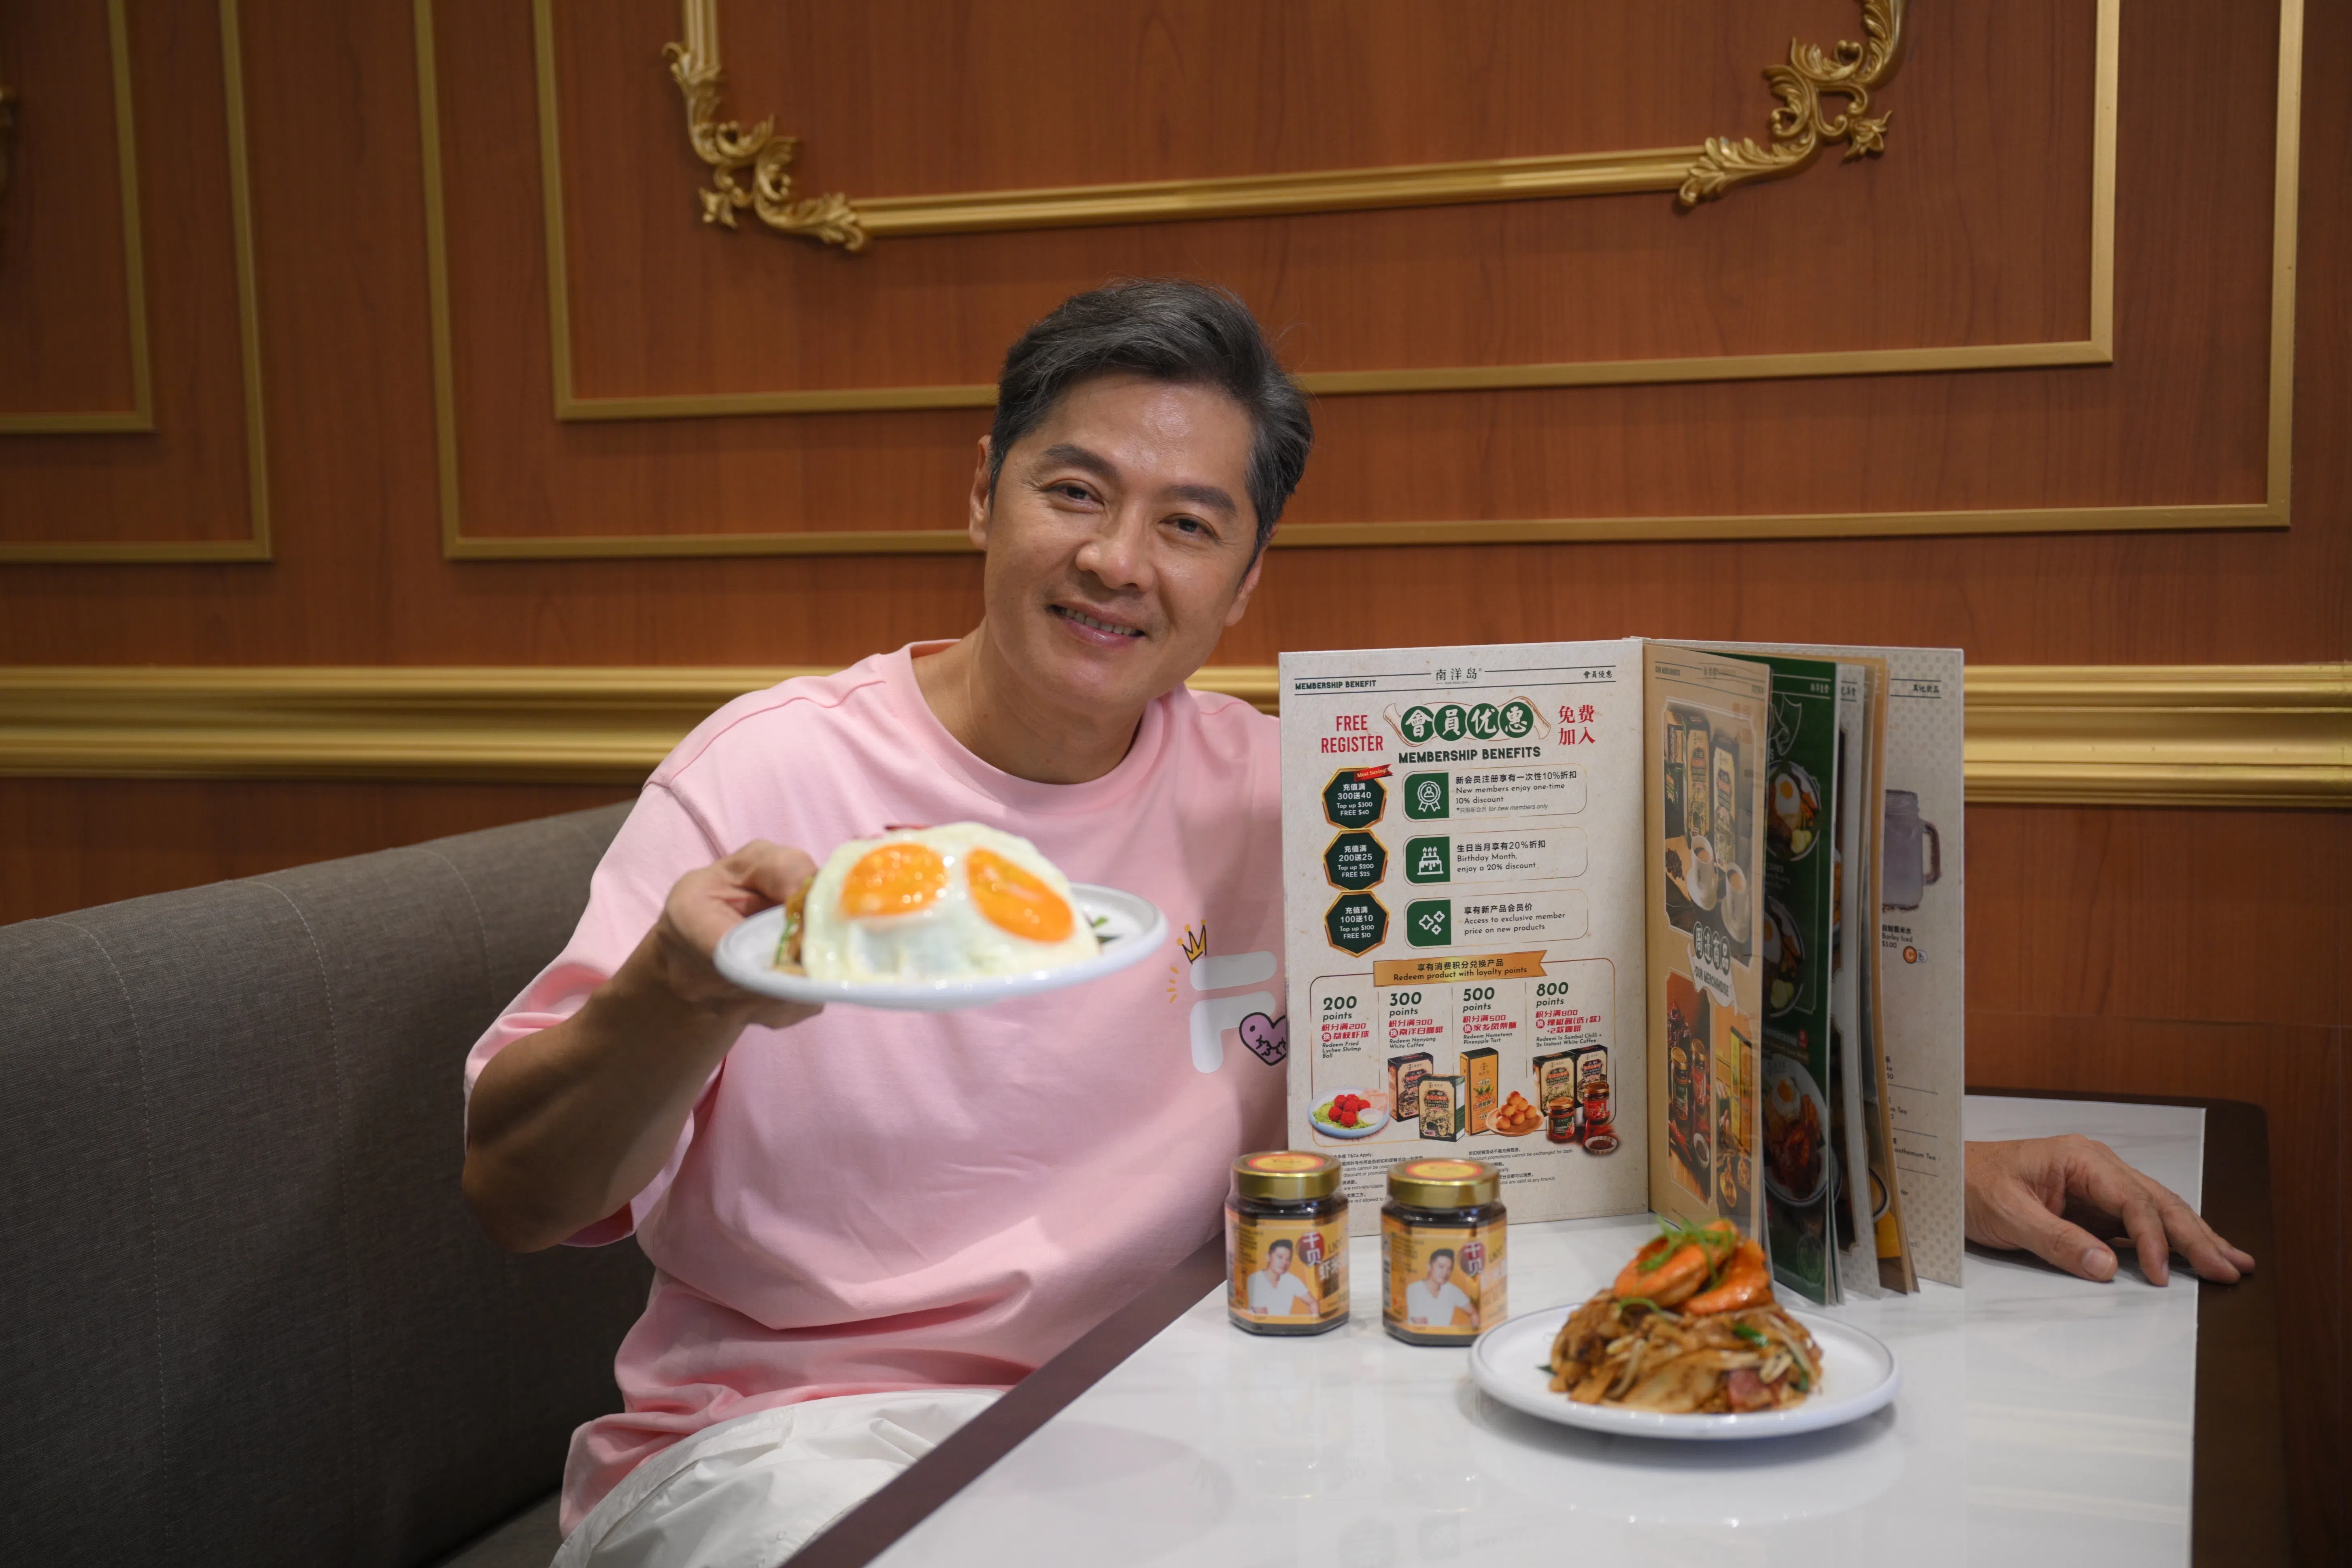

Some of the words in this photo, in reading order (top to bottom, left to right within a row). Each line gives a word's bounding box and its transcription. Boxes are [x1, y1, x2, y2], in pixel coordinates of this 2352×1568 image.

[1295, 681, 1343, 690] MEMBERSHIP
[1558, 705, 1595, 725] 免费
[1336, 715, 1368, 731] FREE
[1558, 727, 1596, 746] 加入
[1321, 735, 1383, 753] REGISTER
[1399, 749, 1478, 764] MEMBERSHIP
[1482, 746, 1541, 760] BENEFITS
[1455, 771, 1577, 784] 新会员注册享有一次性10%折扣
[1338, 792, 1371, 800] 300送40
[1344, 845, 1367, 853] 充值满
[1457, 840, 1545, 852] 生日当月享有20%折扣
[1339, 853, 1373, 862] 200送25
[1458, 854, 1489, 862] Birthday
[1457, 865, 1477, 873] enjoy
[1345, 906, 1368, 914] 充值满
[1464, 903, 1532, 915] 享有新产品会员价
[1340, 915, 1373, 923] 100送10
[1501, 914, 1533, 922] exclusive
[1536, 911, 1565, 920] member
[1464, 927, 1482, 936] price
[1514, 924, 1545, 933] products
[1882, 933, 1899, 941] Barley
[1417, 958, 1504, 971] 享有消费积分兑换产品
[1427, 972, 1456, 980] product
[1459, 969, 1474, 977] with
[1477, 968, 1502, 977] loyalty
[1504, 967, 1527, 975] points
[1463, 987, 1495, 1001] 500
[1536, 982, 1568, 996] 800
[1323, 996, 1357, 1011] 200
[1389, 992, 1422, 1006] 300
[1536, 998, 1564, 1008] points
[1389, 1008, 1418, 1018] points
[1463, 1003, 1491, 1013] points
[1323, 1013, 1352, 1022] points
[1463, 1015, 1506, 1023] 积分满500
[1536, 1010, 1578, 1018] 积分满800
[1321, 1023, 1366, 1031] 积分满200
[1389, 1019, 1433, 1028] 积分满300
